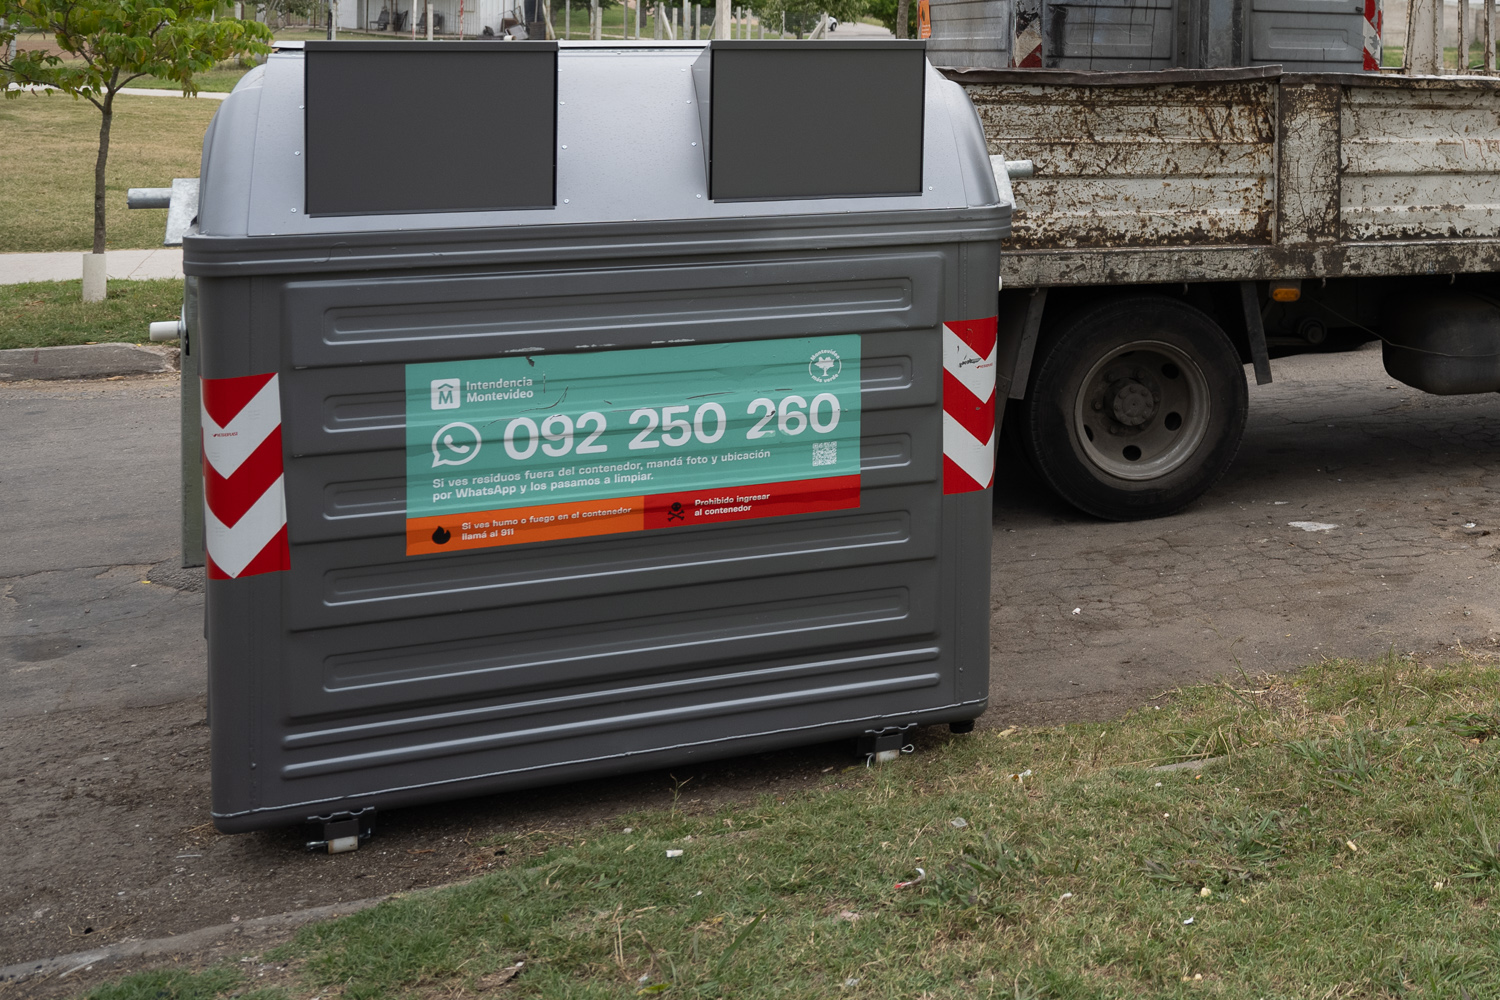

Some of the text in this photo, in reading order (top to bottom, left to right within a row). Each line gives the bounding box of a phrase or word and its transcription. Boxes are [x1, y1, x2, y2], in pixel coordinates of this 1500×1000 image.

[466, 376, 533, 390] Intendencia
[467, 388, 534, 403] Montevideo
[504, 393, 840, 460] 092 250 260
[433, 449, 770, 488] Si ves residuos fuera del contenedor, mandá foto y ubicación
[433, 492, 452, 503] por
[455, 485, 516, 498] WhatsApp
[520, 485, 527, 494] y
[530, 482, 547, 491] los
[550, 478, 601, 491] pasamos
[614, 472, 654, 484] limpiar.
[695, 494, 770, 506] Prohibido ingresar
[704, 505, 752, 515] contenedor
[462, 522, 471, 530] Si
[492, 519, 518, 527] humo
[529, 515, 555, 523] fuego
[571, 511, 580, 519] el
[582, 507, 632, 518] contenedor
[462, 528, 514, 540] llamá al 911
